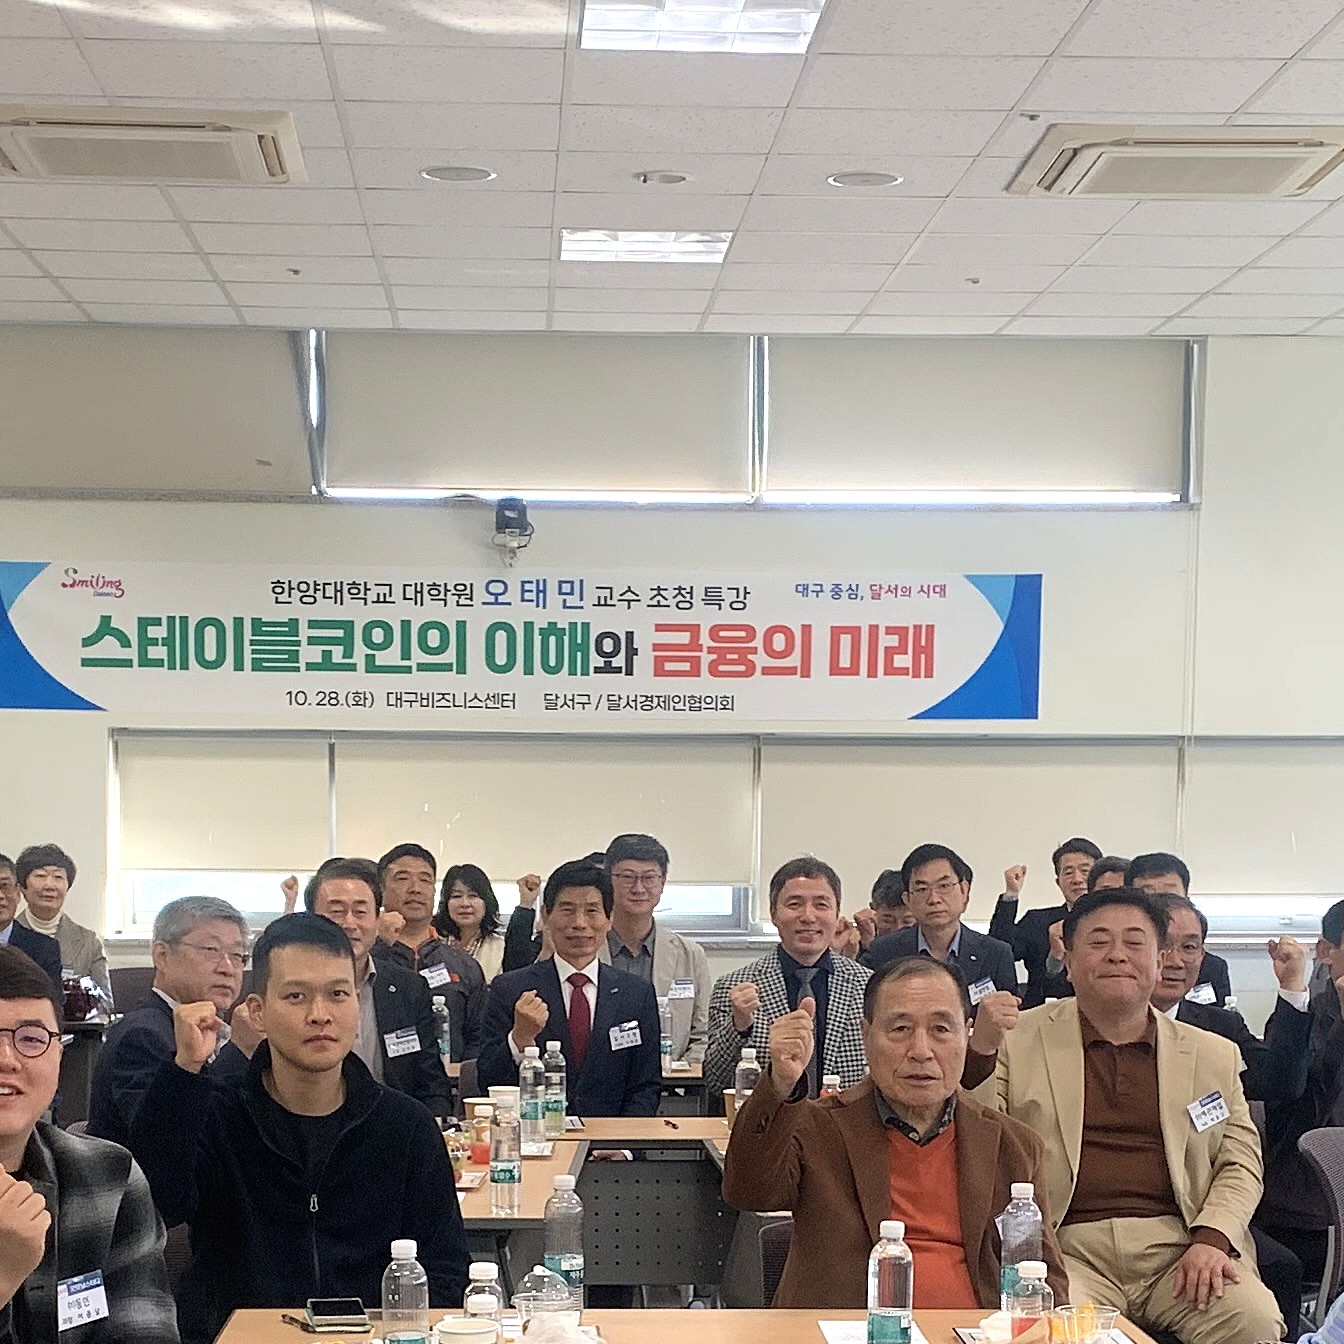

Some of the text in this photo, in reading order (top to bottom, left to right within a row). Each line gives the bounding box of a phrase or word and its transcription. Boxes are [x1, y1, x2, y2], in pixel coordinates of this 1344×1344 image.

[60, 567, 125, 598] Smiling
[270, 579, 396, 606] 한양대학교
[401, 580, 475, 607] 대학원
[592, 585, 641, 610] 교수
[646, 585, 695, 611] 초청
[701, 586, 751, 611] 특강
[794, 582, 947, 601] 대구 중심, 달서의 시대
[80, 614, 936, 679] 스테이블코인의 이해와 금융의 미래
[386, 691, 517, 710] 대구비즈니스센터
[543, 693, 592, 711] 달서구
[606, 693, 735, 712] 달서경제인협의회
